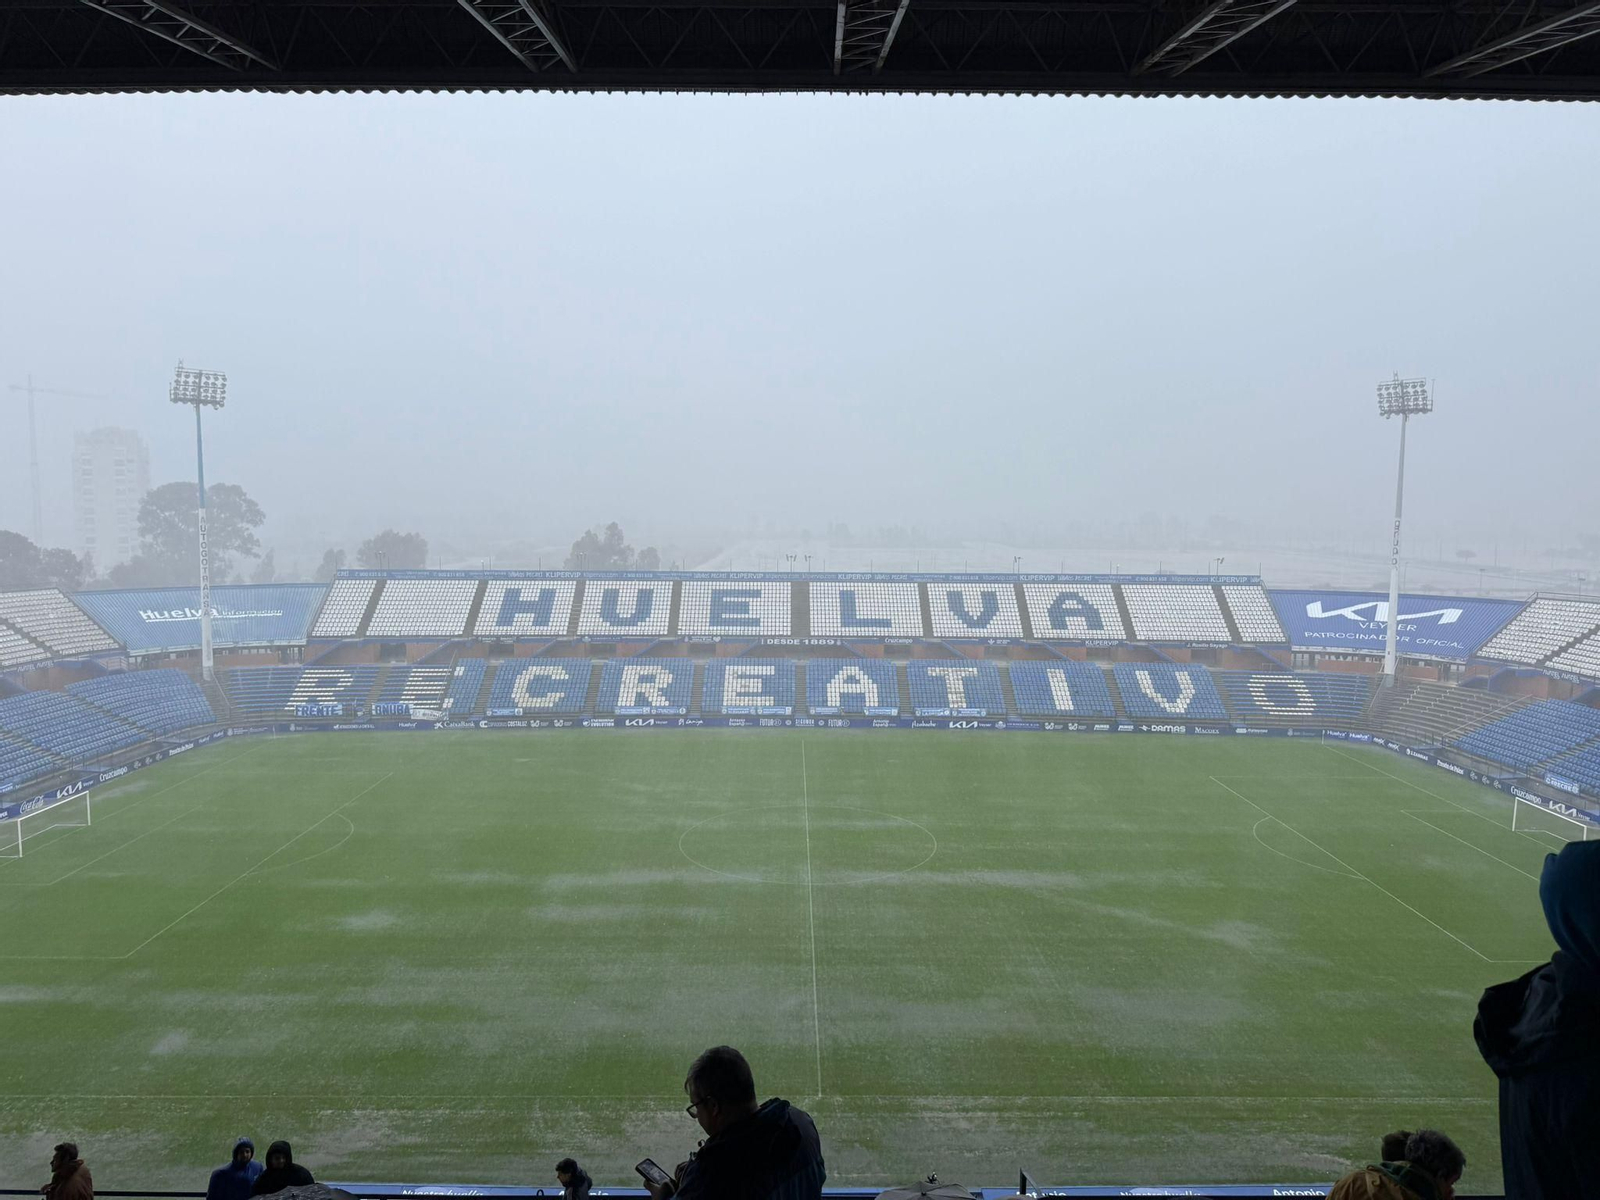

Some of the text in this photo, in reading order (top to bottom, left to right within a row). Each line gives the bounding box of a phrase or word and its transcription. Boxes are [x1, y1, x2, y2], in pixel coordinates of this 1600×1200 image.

[1358, 621, 1417, 632] VEYER
[1416, 637, 1465, 649] OFICIAL
[295, 705, 340, 717] FRENTE
[1151, 725, 1186, 733] DAMAS
[99, 766, 128, 782] Cruzcampo
[1510, 785, 1542, 804] Cruzcampo
